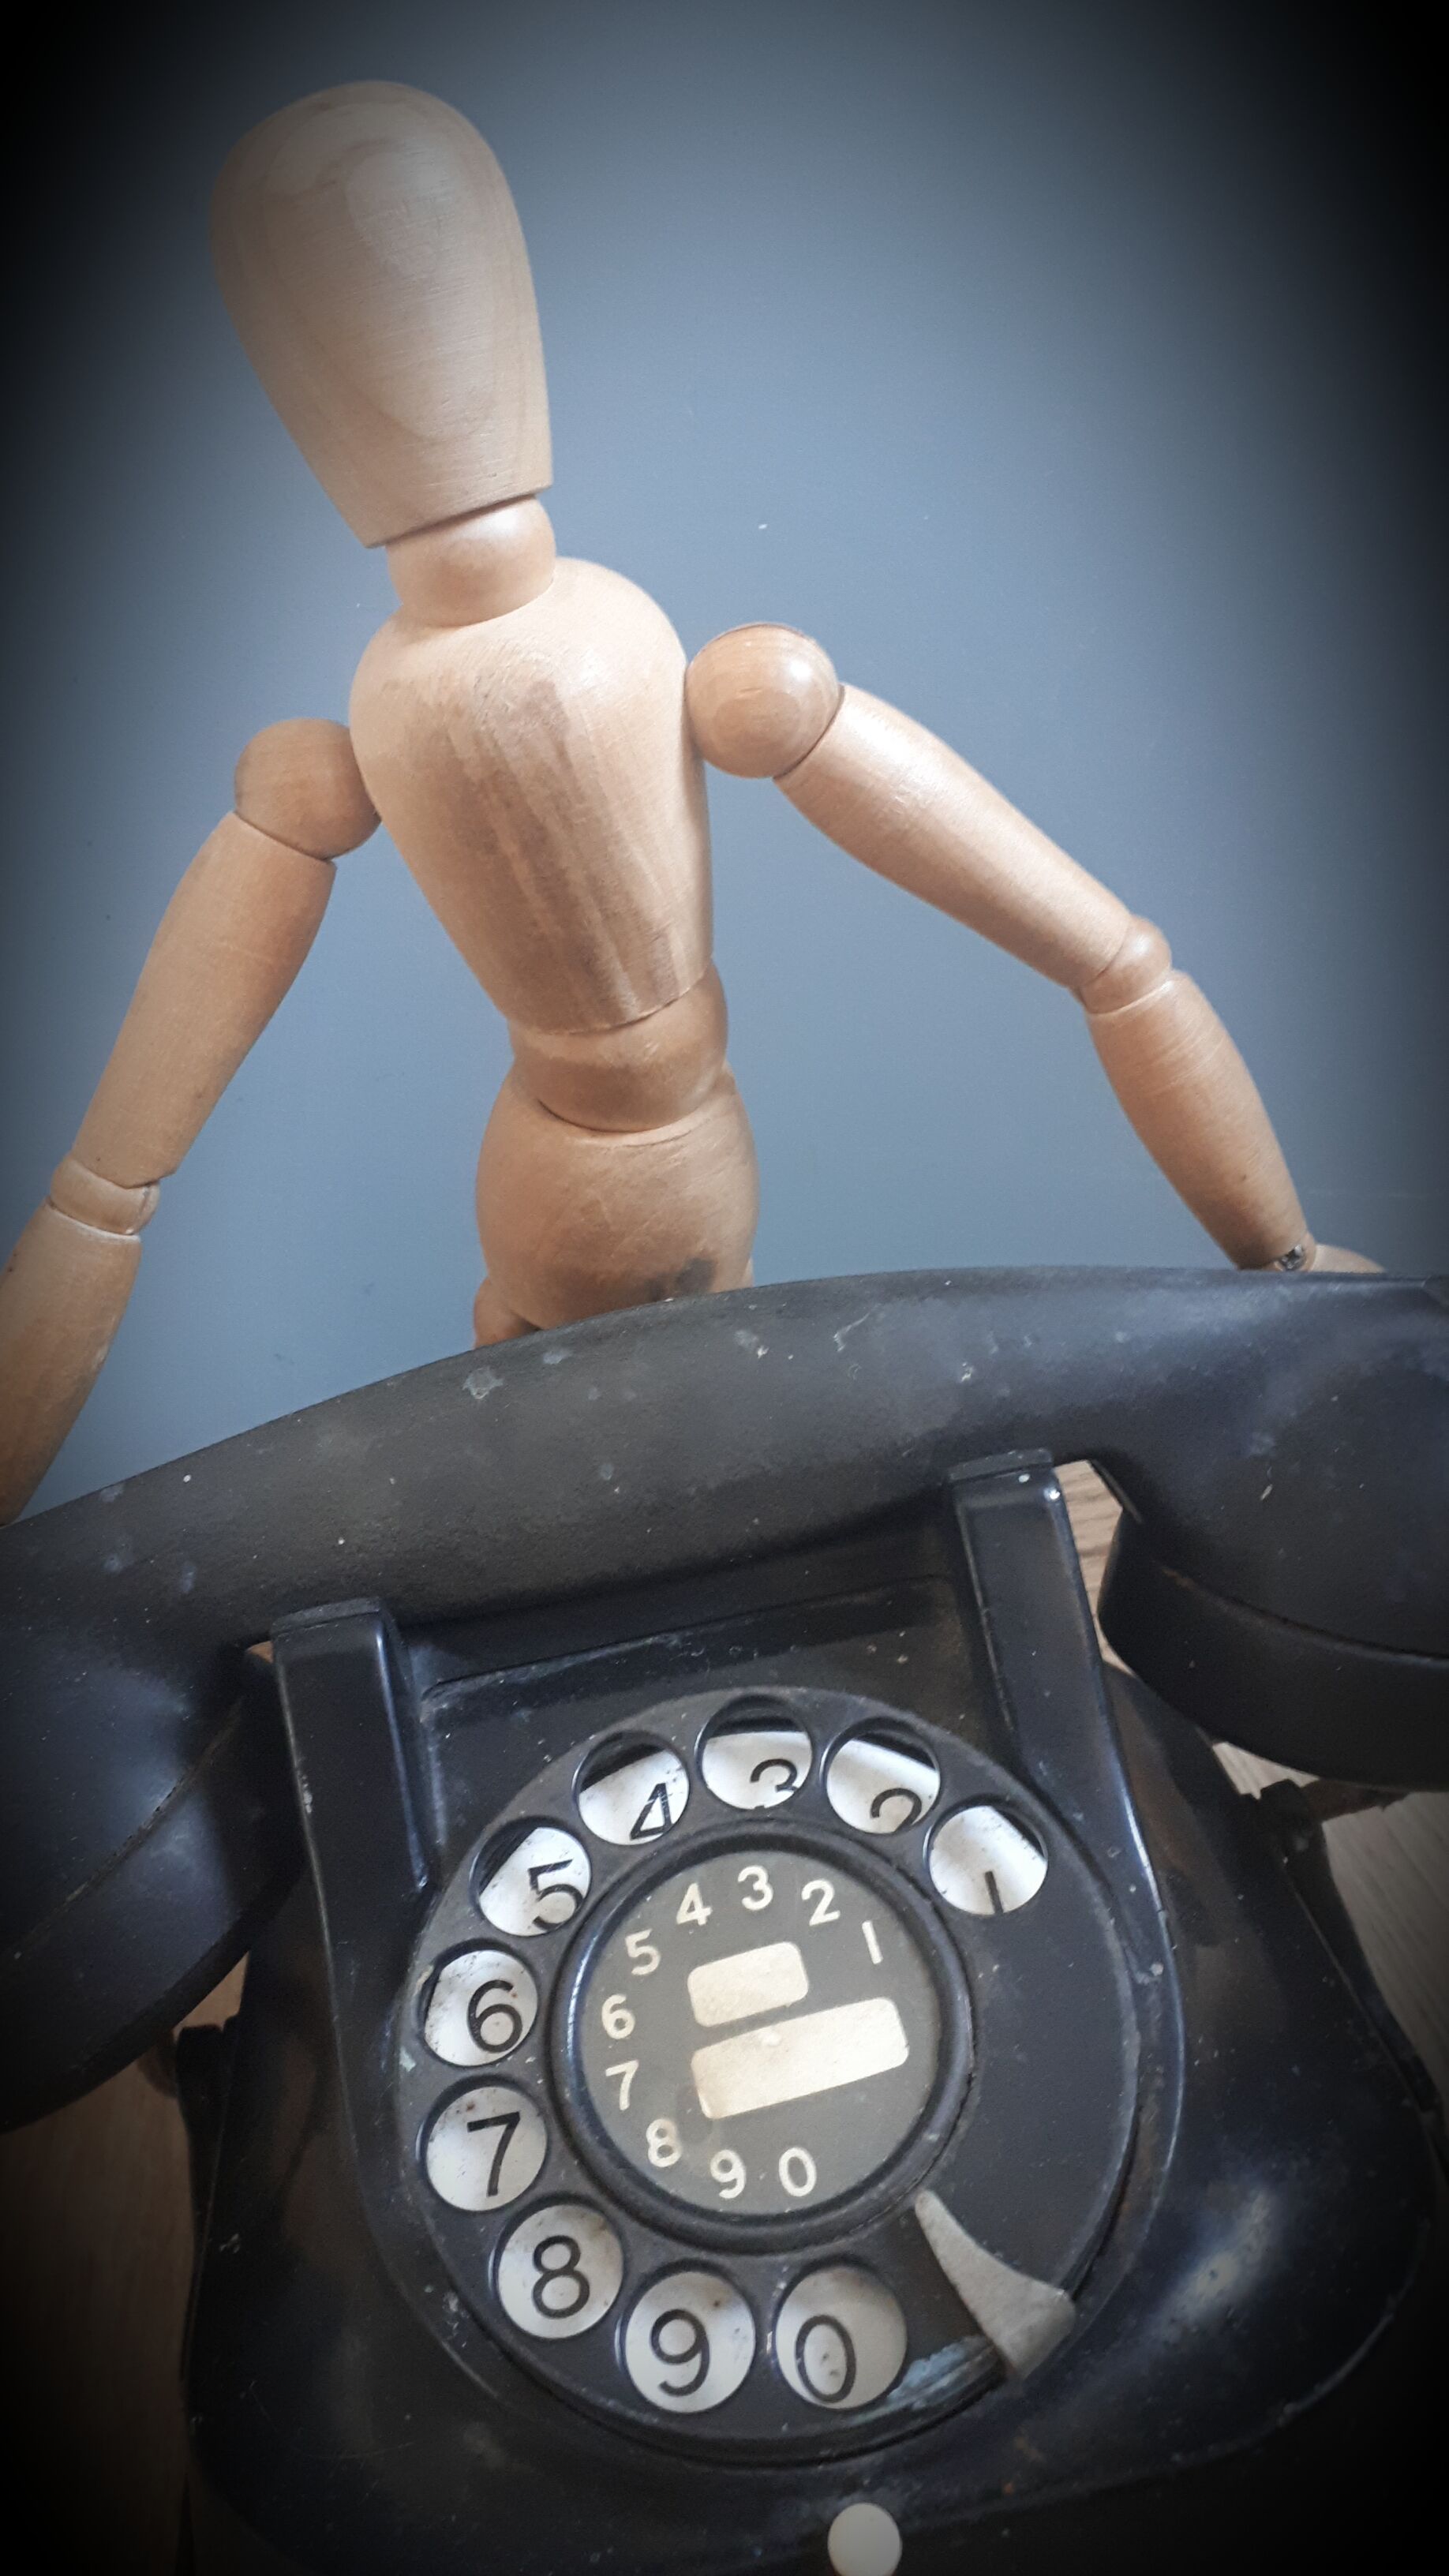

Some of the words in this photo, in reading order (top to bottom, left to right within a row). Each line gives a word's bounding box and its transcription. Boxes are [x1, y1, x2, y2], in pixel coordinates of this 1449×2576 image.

[630, 1783, 676, 1840] 4
[529, 1859, 584, 1930] 5
[676, 1883, 712, 1926] 4
[737, 1865, 773, 1911] 3
[801, 1879, 840, 1926] 2
[625, 1929, 661, 1975] 5
[862, 1920, 883, 1964] 1
[468, 1979, 522, 2053] 6
[601, 1994, 635, 2039] 6
[605, 2060, 639, 2110] 7
[466, 2112, 521, 2196] 7
[646, 2118, 683, 2167] 8
[710, 2149, 747, 2199] 9
[778, 2147, 817, 2197] 0
[532, 2234, 591, 2319] 8
[650, 2308, 710, 2397] 9
[795, 2314, 857, 2402] 0
